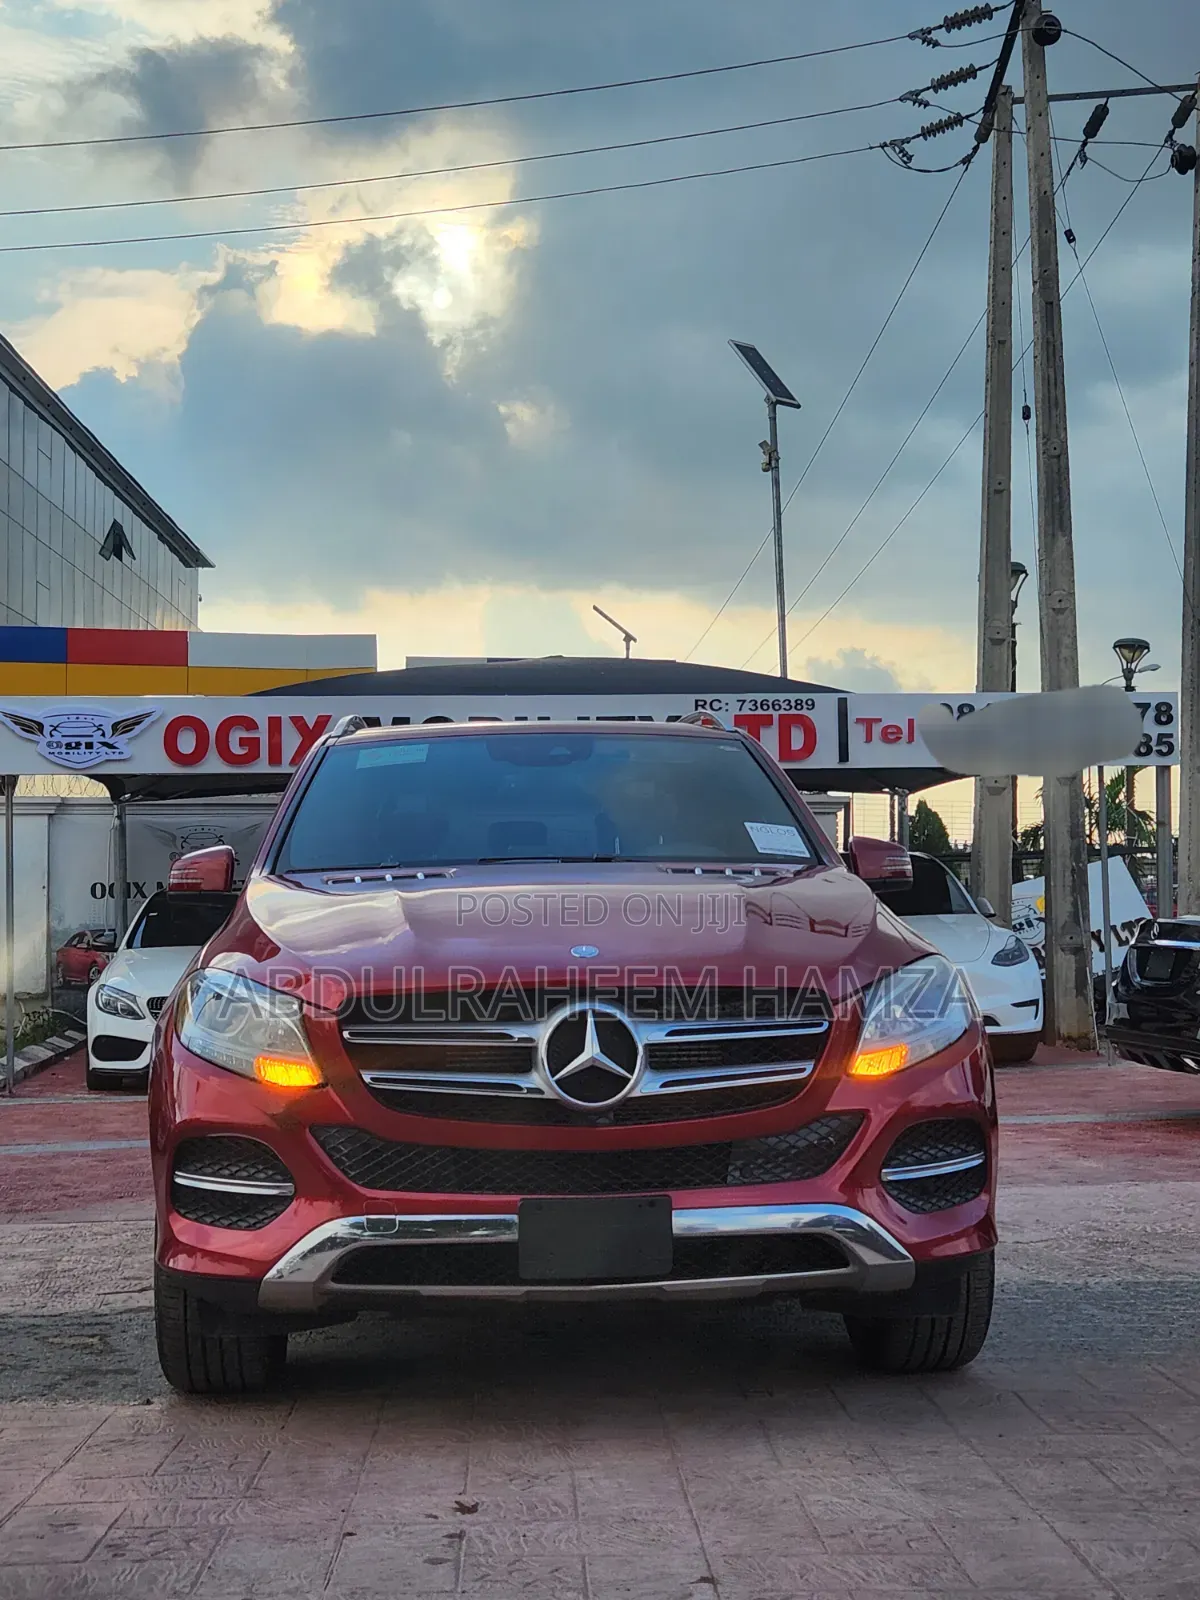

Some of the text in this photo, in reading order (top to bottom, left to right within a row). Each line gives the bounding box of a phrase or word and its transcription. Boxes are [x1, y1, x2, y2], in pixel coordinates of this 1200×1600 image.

[694, 699, 816, 712] RC: 7366389
[163, 714, 332, 767] OGIX
[854, 717, 915, 744] Tel
